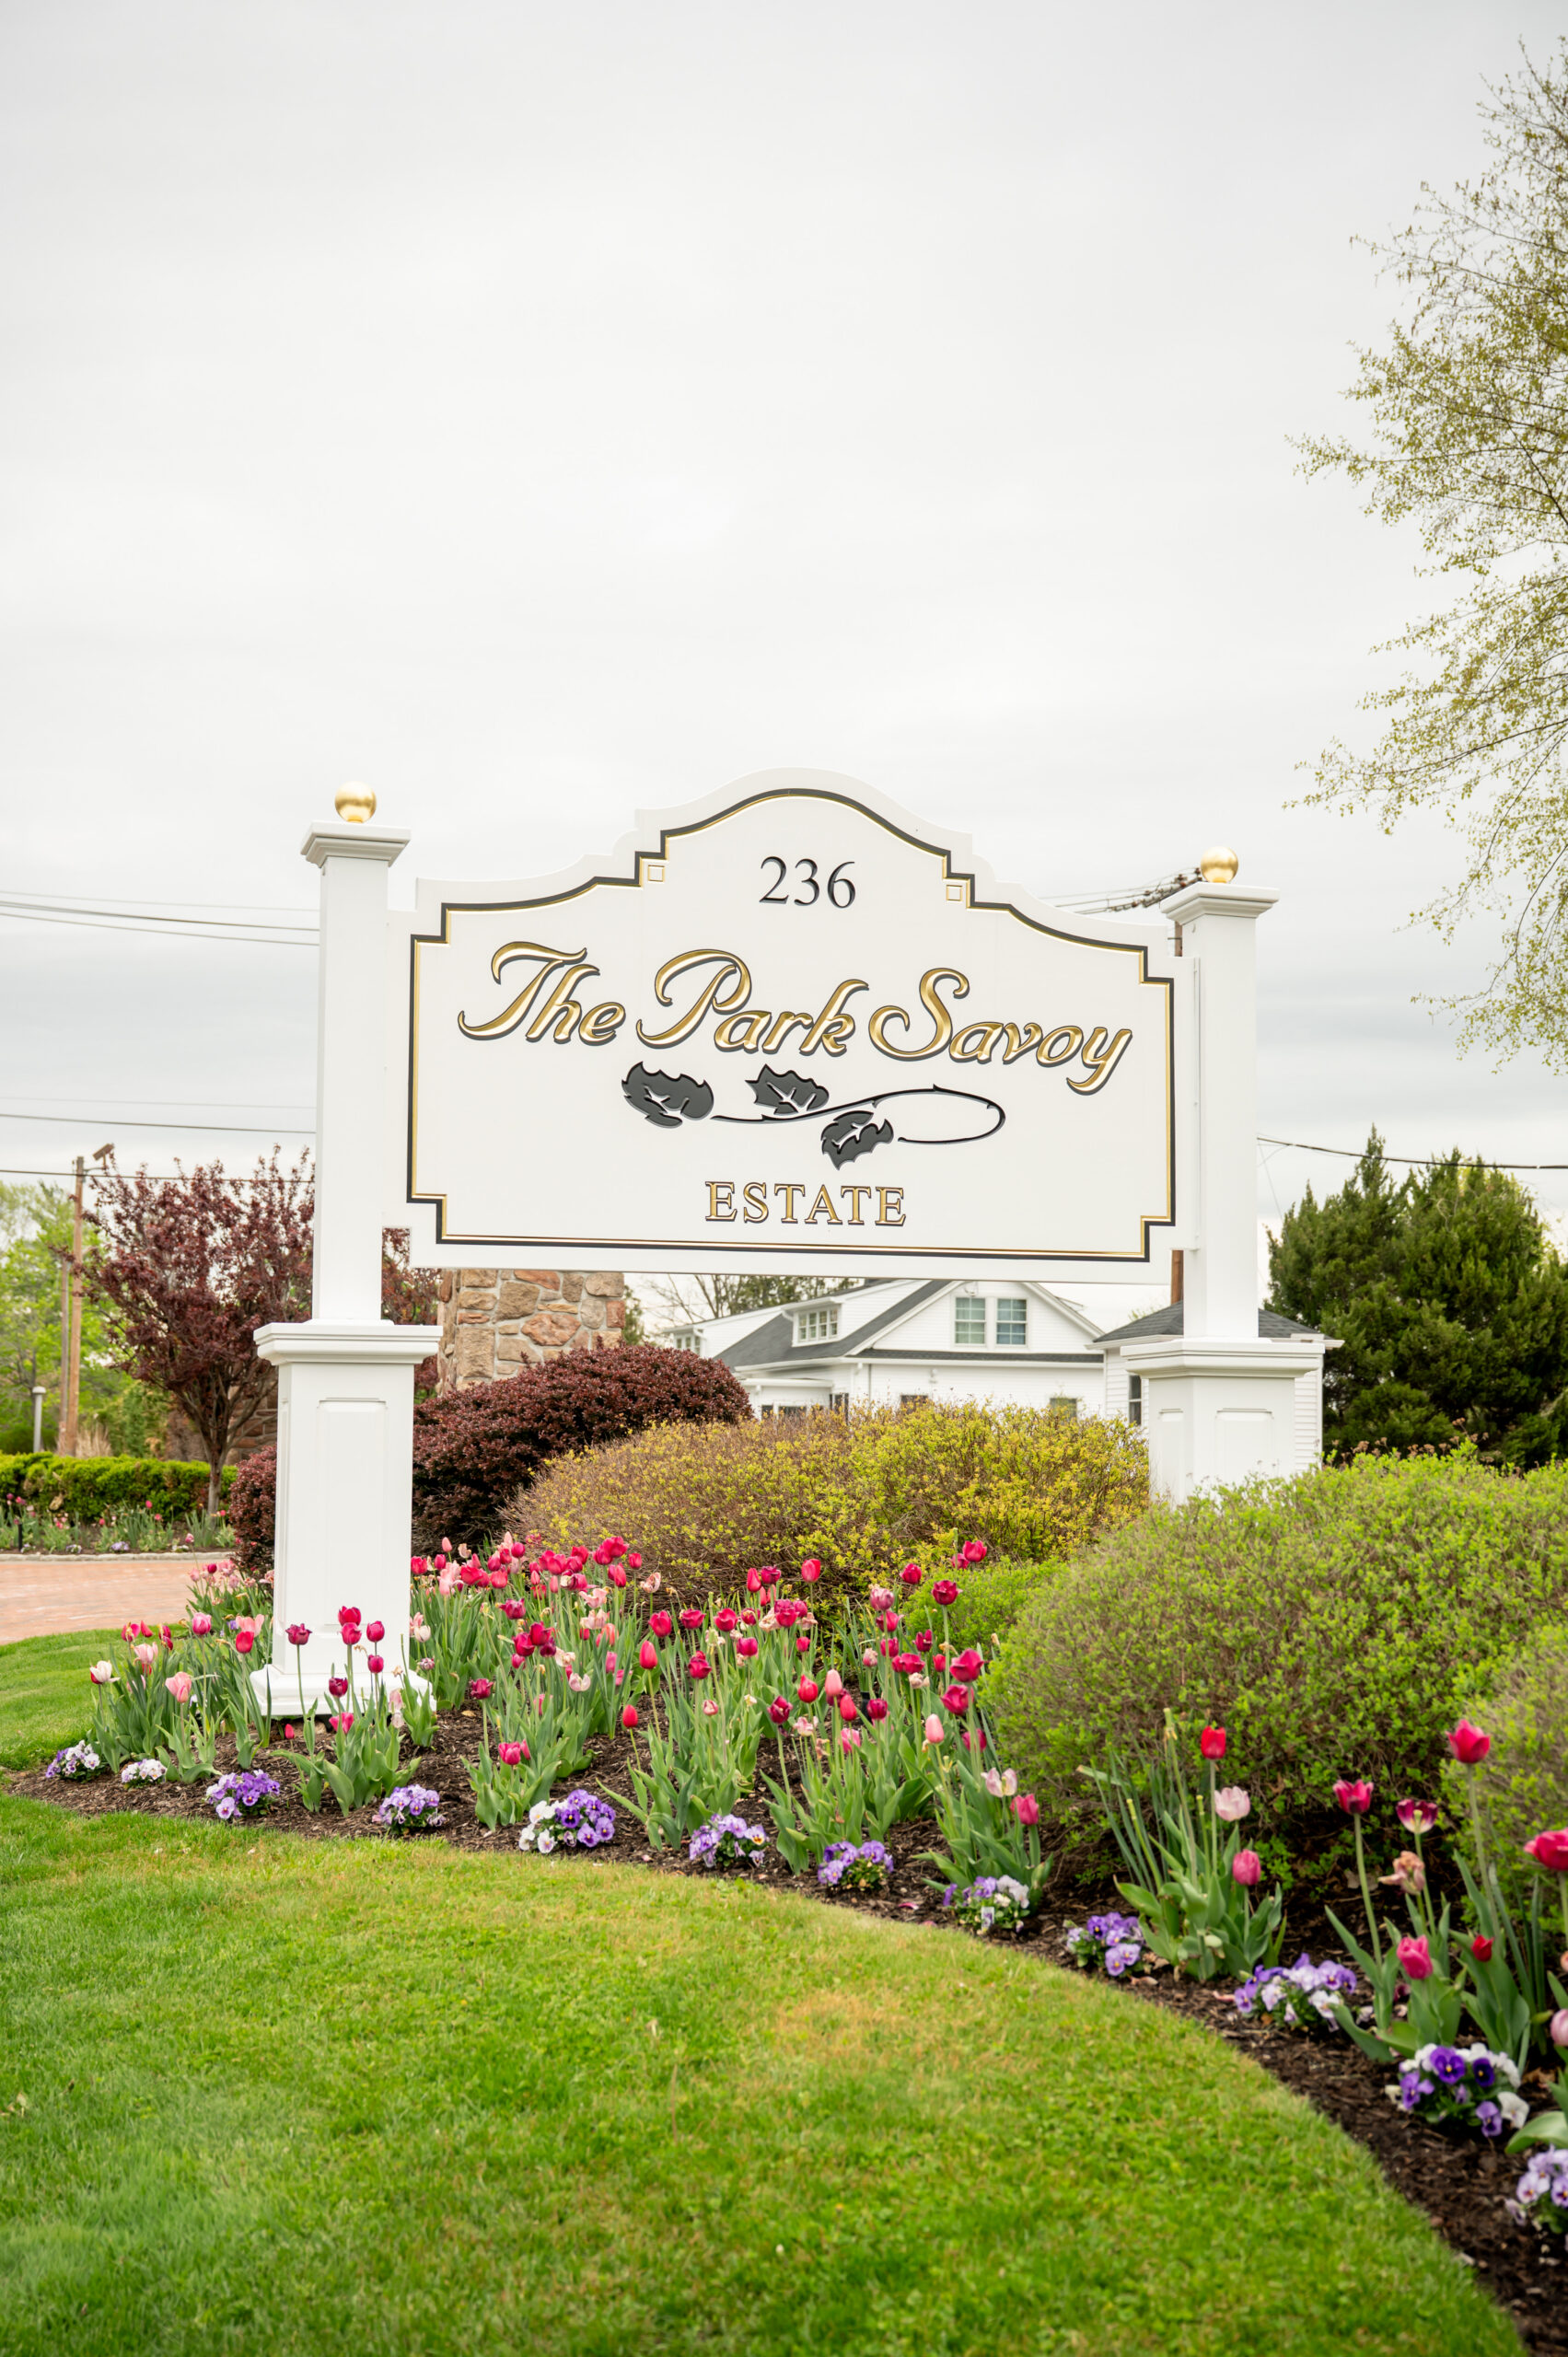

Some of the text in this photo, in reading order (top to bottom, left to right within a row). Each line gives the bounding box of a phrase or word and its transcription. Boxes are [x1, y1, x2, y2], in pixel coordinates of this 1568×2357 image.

[759, 855, 857, 910] 236
[457, 940, 1133, 1097] The Park Savoy
[704, 1180, 907, 1227] ESTATE
